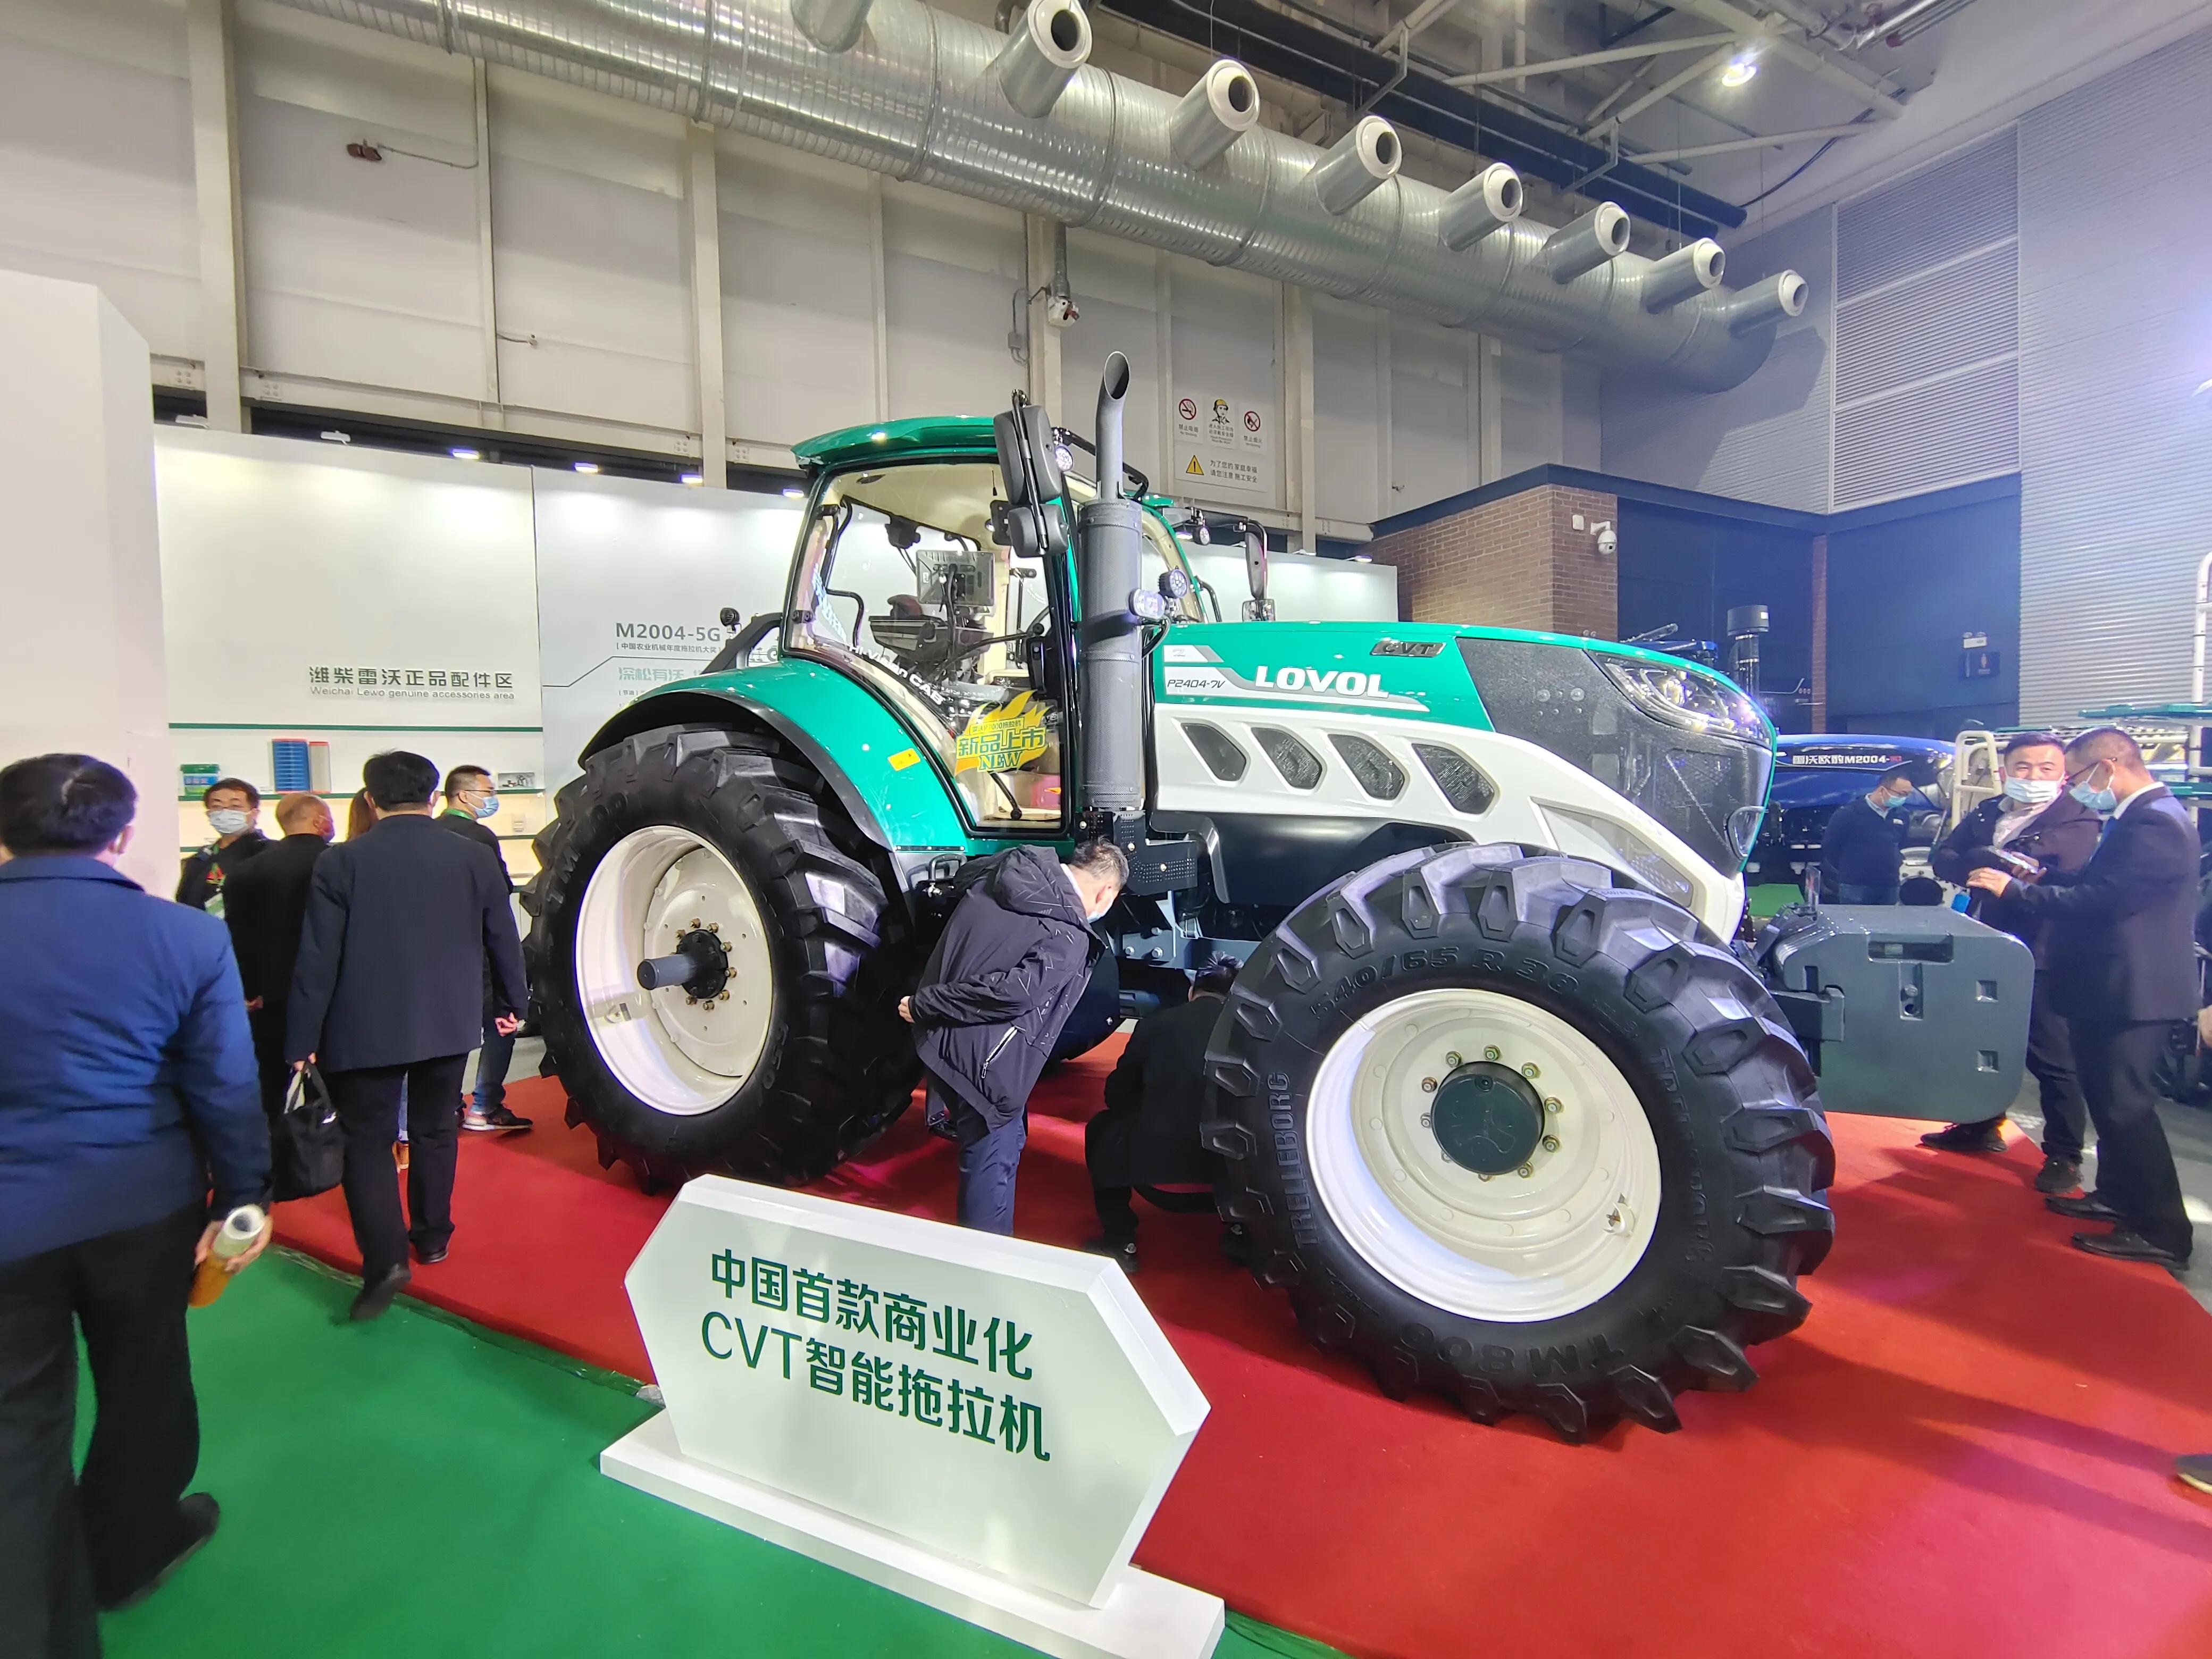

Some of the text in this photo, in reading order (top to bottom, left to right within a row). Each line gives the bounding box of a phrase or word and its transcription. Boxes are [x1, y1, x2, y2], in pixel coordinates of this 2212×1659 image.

[616, 622, 720, 642] M2004-5G
[1382, 642, 1434, 655] CVT
[309, 666, 513, 689] 潍柴雷沃正品配件区
[310, 686, 353, 696] Weichai
[357, 688, 385, 697] Lewo
[909, 673, 945, 705] CAB
[1254, 665, 1389, 699] LOVOL
[958, 728, 1045, 757] 新品上市
[979, 751, 1023, 770] NEW
[1310, 946, 1459, 1019] 540/65
[1471, 948, 1505, 972] R
[1267, 1072, 1320, 1249] TRELLEBORG
[711, 1247, 1033, 1381] 中国首款商业化
[701, 1311, 1051, 1462] CVT智能拖拉机
